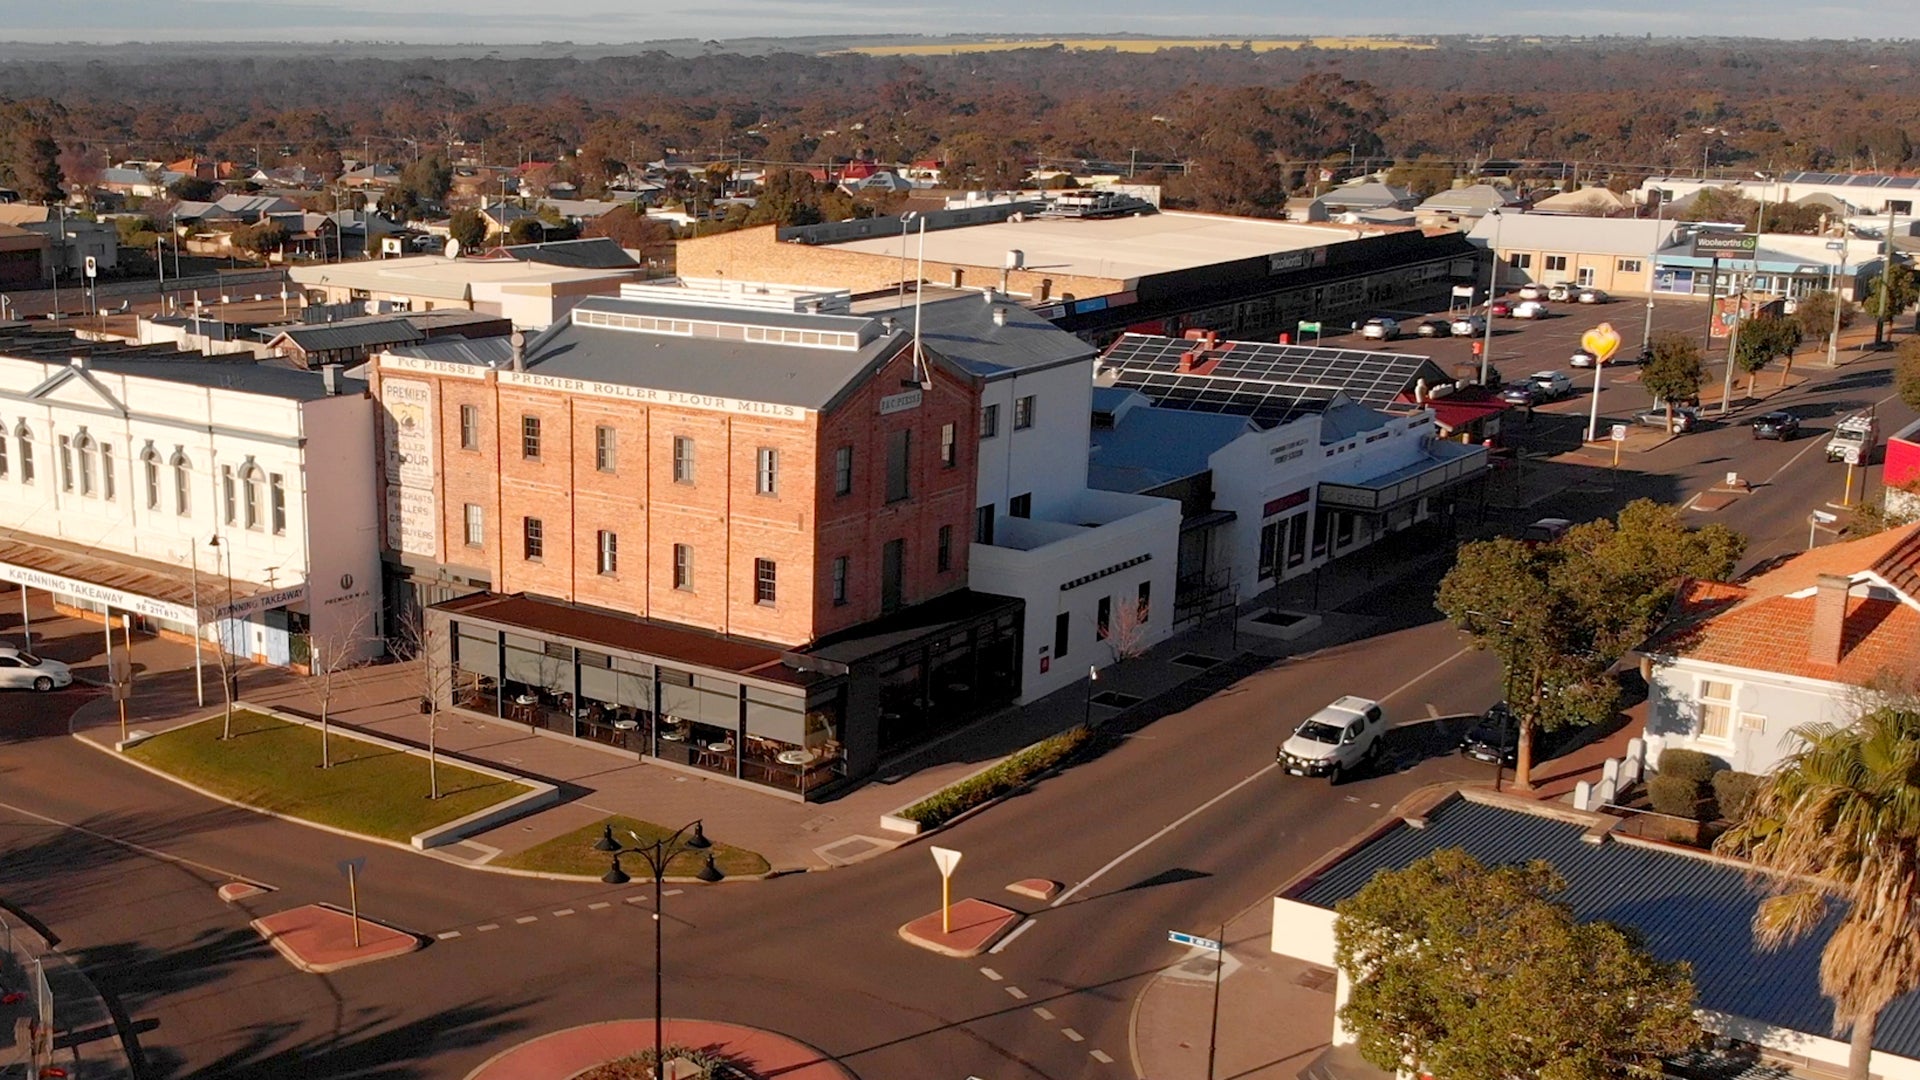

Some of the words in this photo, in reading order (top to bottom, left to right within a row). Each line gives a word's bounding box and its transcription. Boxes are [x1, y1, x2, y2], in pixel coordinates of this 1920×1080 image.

[1697, 238, 1741, 248] Woolworths
[424, 360, 476, 375] PIESSE
[386, 384, 428, 401] PREMIER
[511, 372, 585, 391] PREMIER
[593, 383, 657, 400] ROLLER
[668, 392, 726, 409] FLOUR
[737, 401, 795, 417] MILLS
[389, 450, 430, 467] FLOUR
[9, 568, 67, 591] KATANNING
[69, 583, 124, 605] TAKEAWAY
[260, 588, 304, 607] TAKEAWAY
